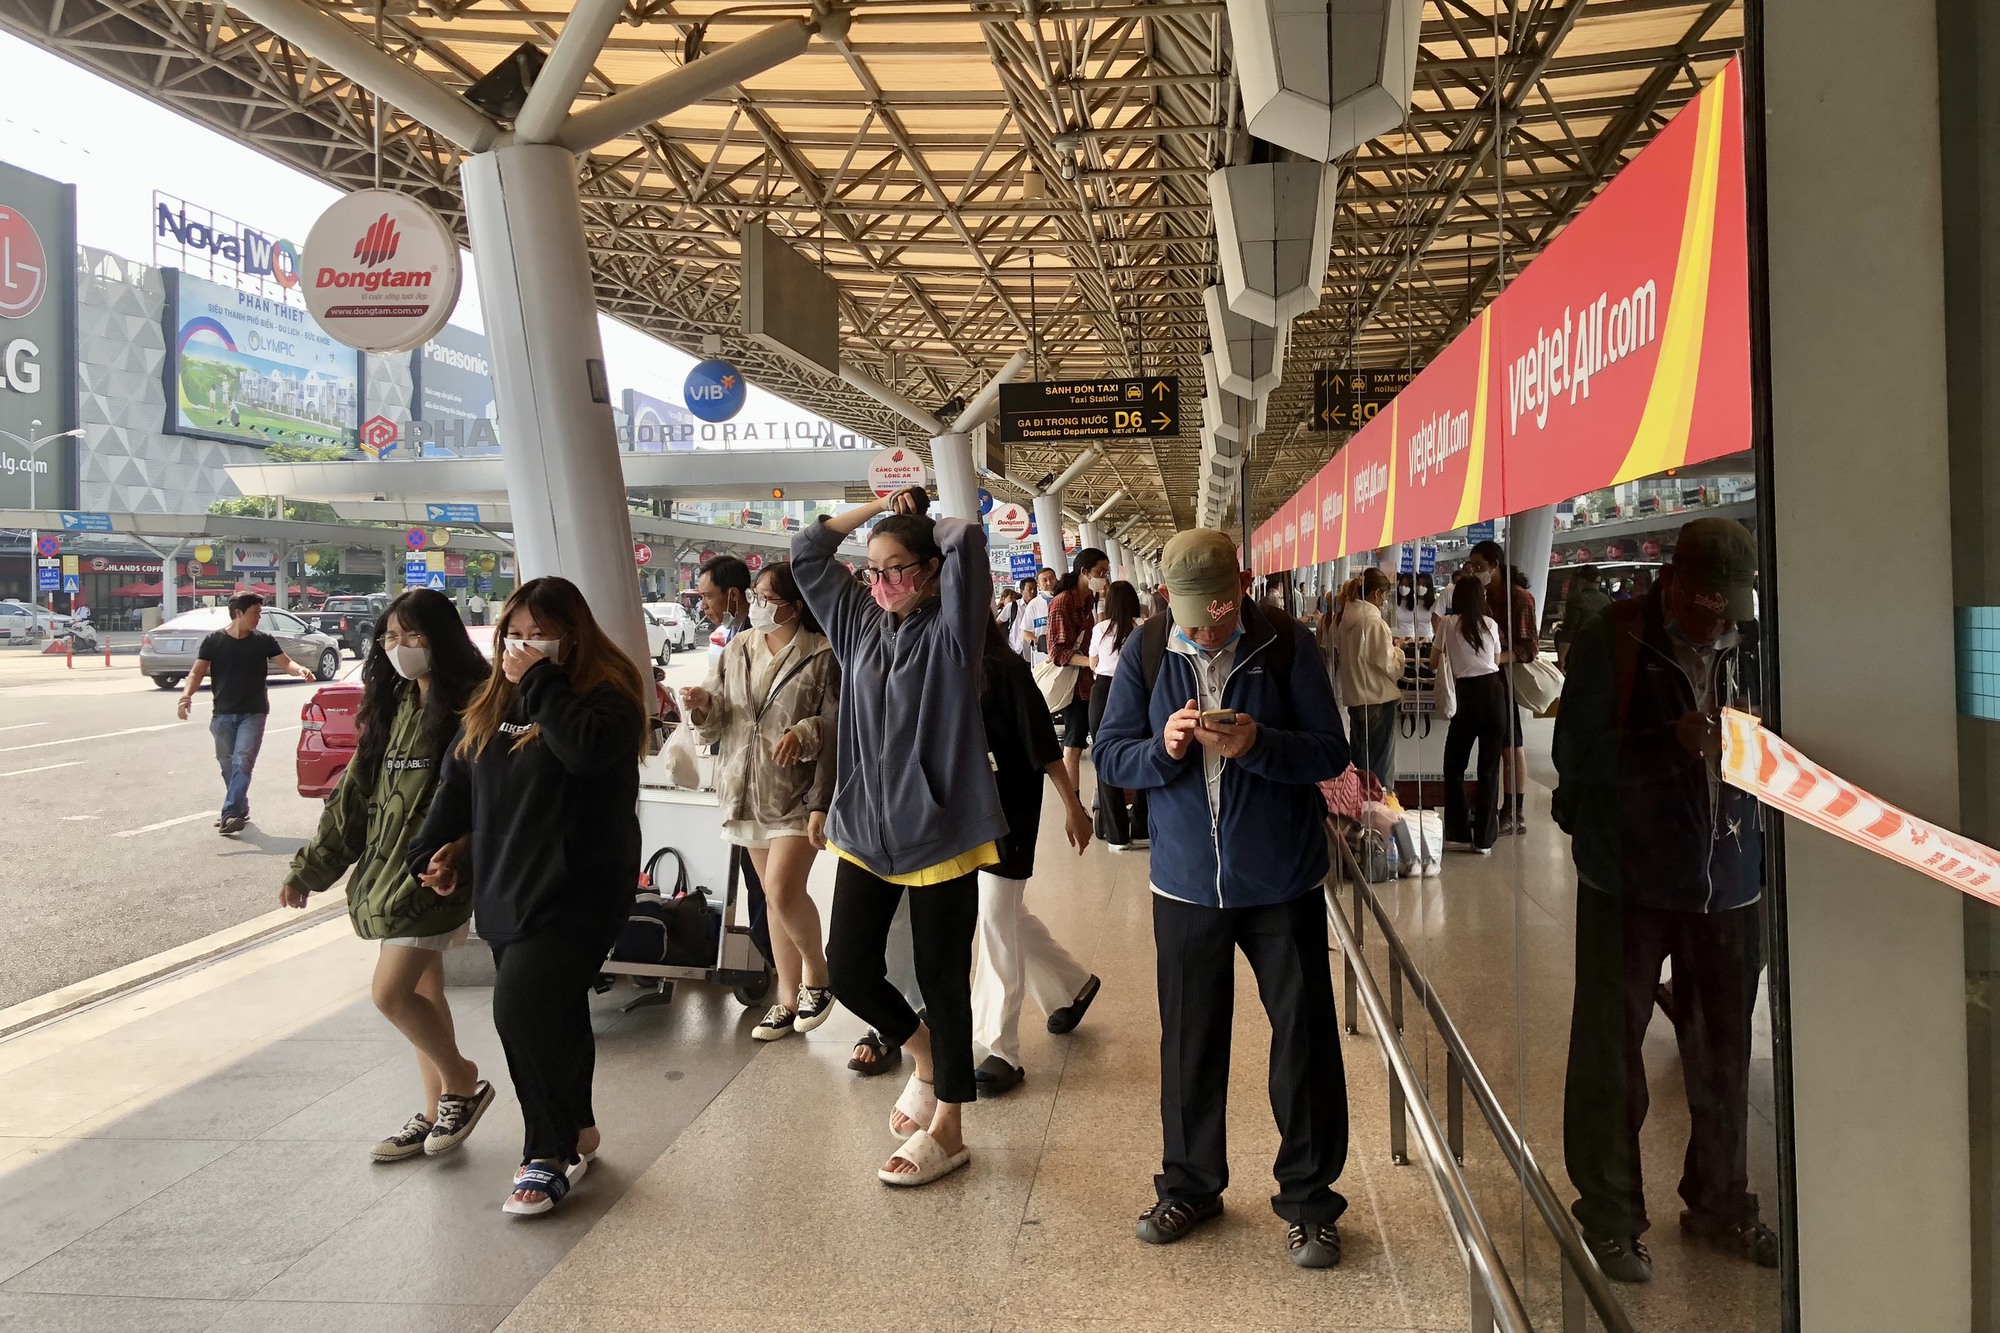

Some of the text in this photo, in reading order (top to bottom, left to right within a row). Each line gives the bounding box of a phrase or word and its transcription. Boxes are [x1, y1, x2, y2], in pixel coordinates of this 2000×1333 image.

[315, 267, 432, 292] Dongtam
[331, 306, 423, 316] www.dongtam.com.vn
[0, 338, 41, 394] G
[424, 339, 489, 376] Panasonic
[689, 385, 724, 401] VIB
[1045, 384, 1119, 395] SẢNH ĐÓN TAXI
[1069, 395, 1119, 404] Taxi Station
[1017, 411, 1143, 429] GA ĐI TRONG NƯỚC D6
[616, 421, 835, 443] CORPORATION
[1023, 429, 1062, 438] Domestic
[1063, 427, 1109, 437] Departures
